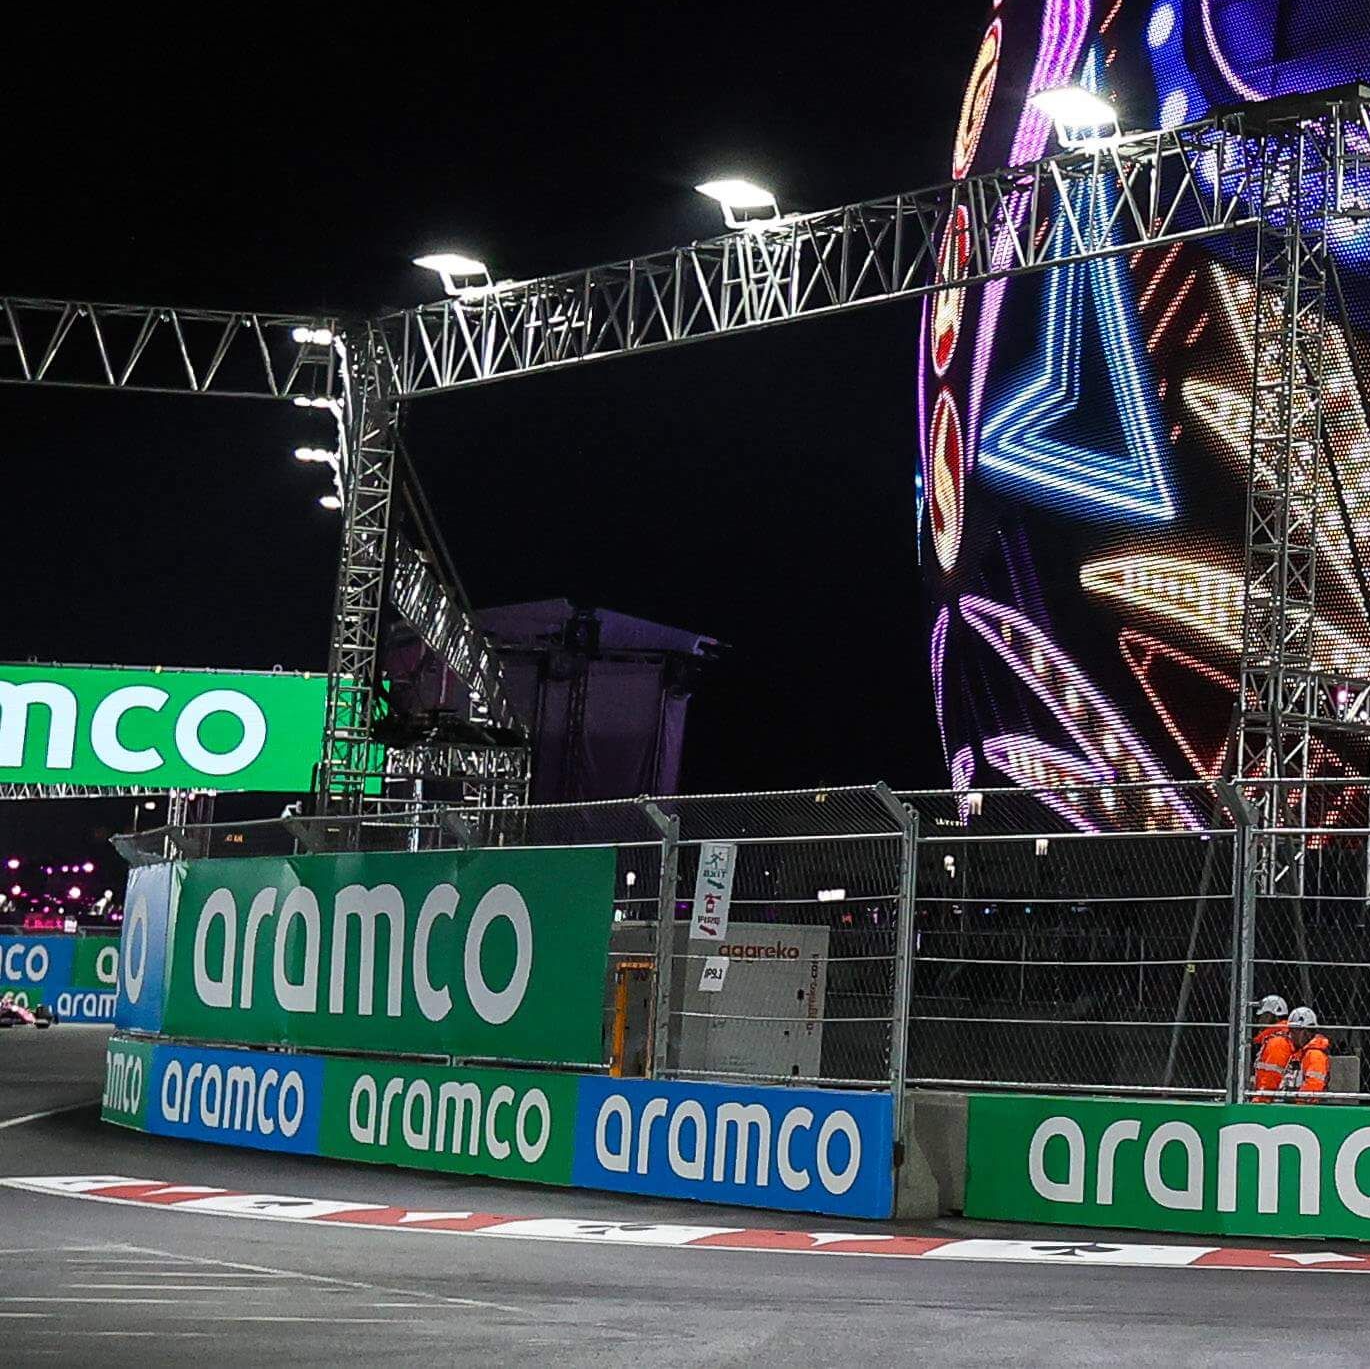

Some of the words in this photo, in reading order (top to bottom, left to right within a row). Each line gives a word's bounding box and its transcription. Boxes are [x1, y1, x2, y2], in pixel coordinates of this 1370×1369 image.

[193, 882, 532, 1025] aramco
[161, 1059, 305, 1138] aramco
[349, 1074, 551, 1164] aramco
[595, 1093, 862, 1196] aramco
